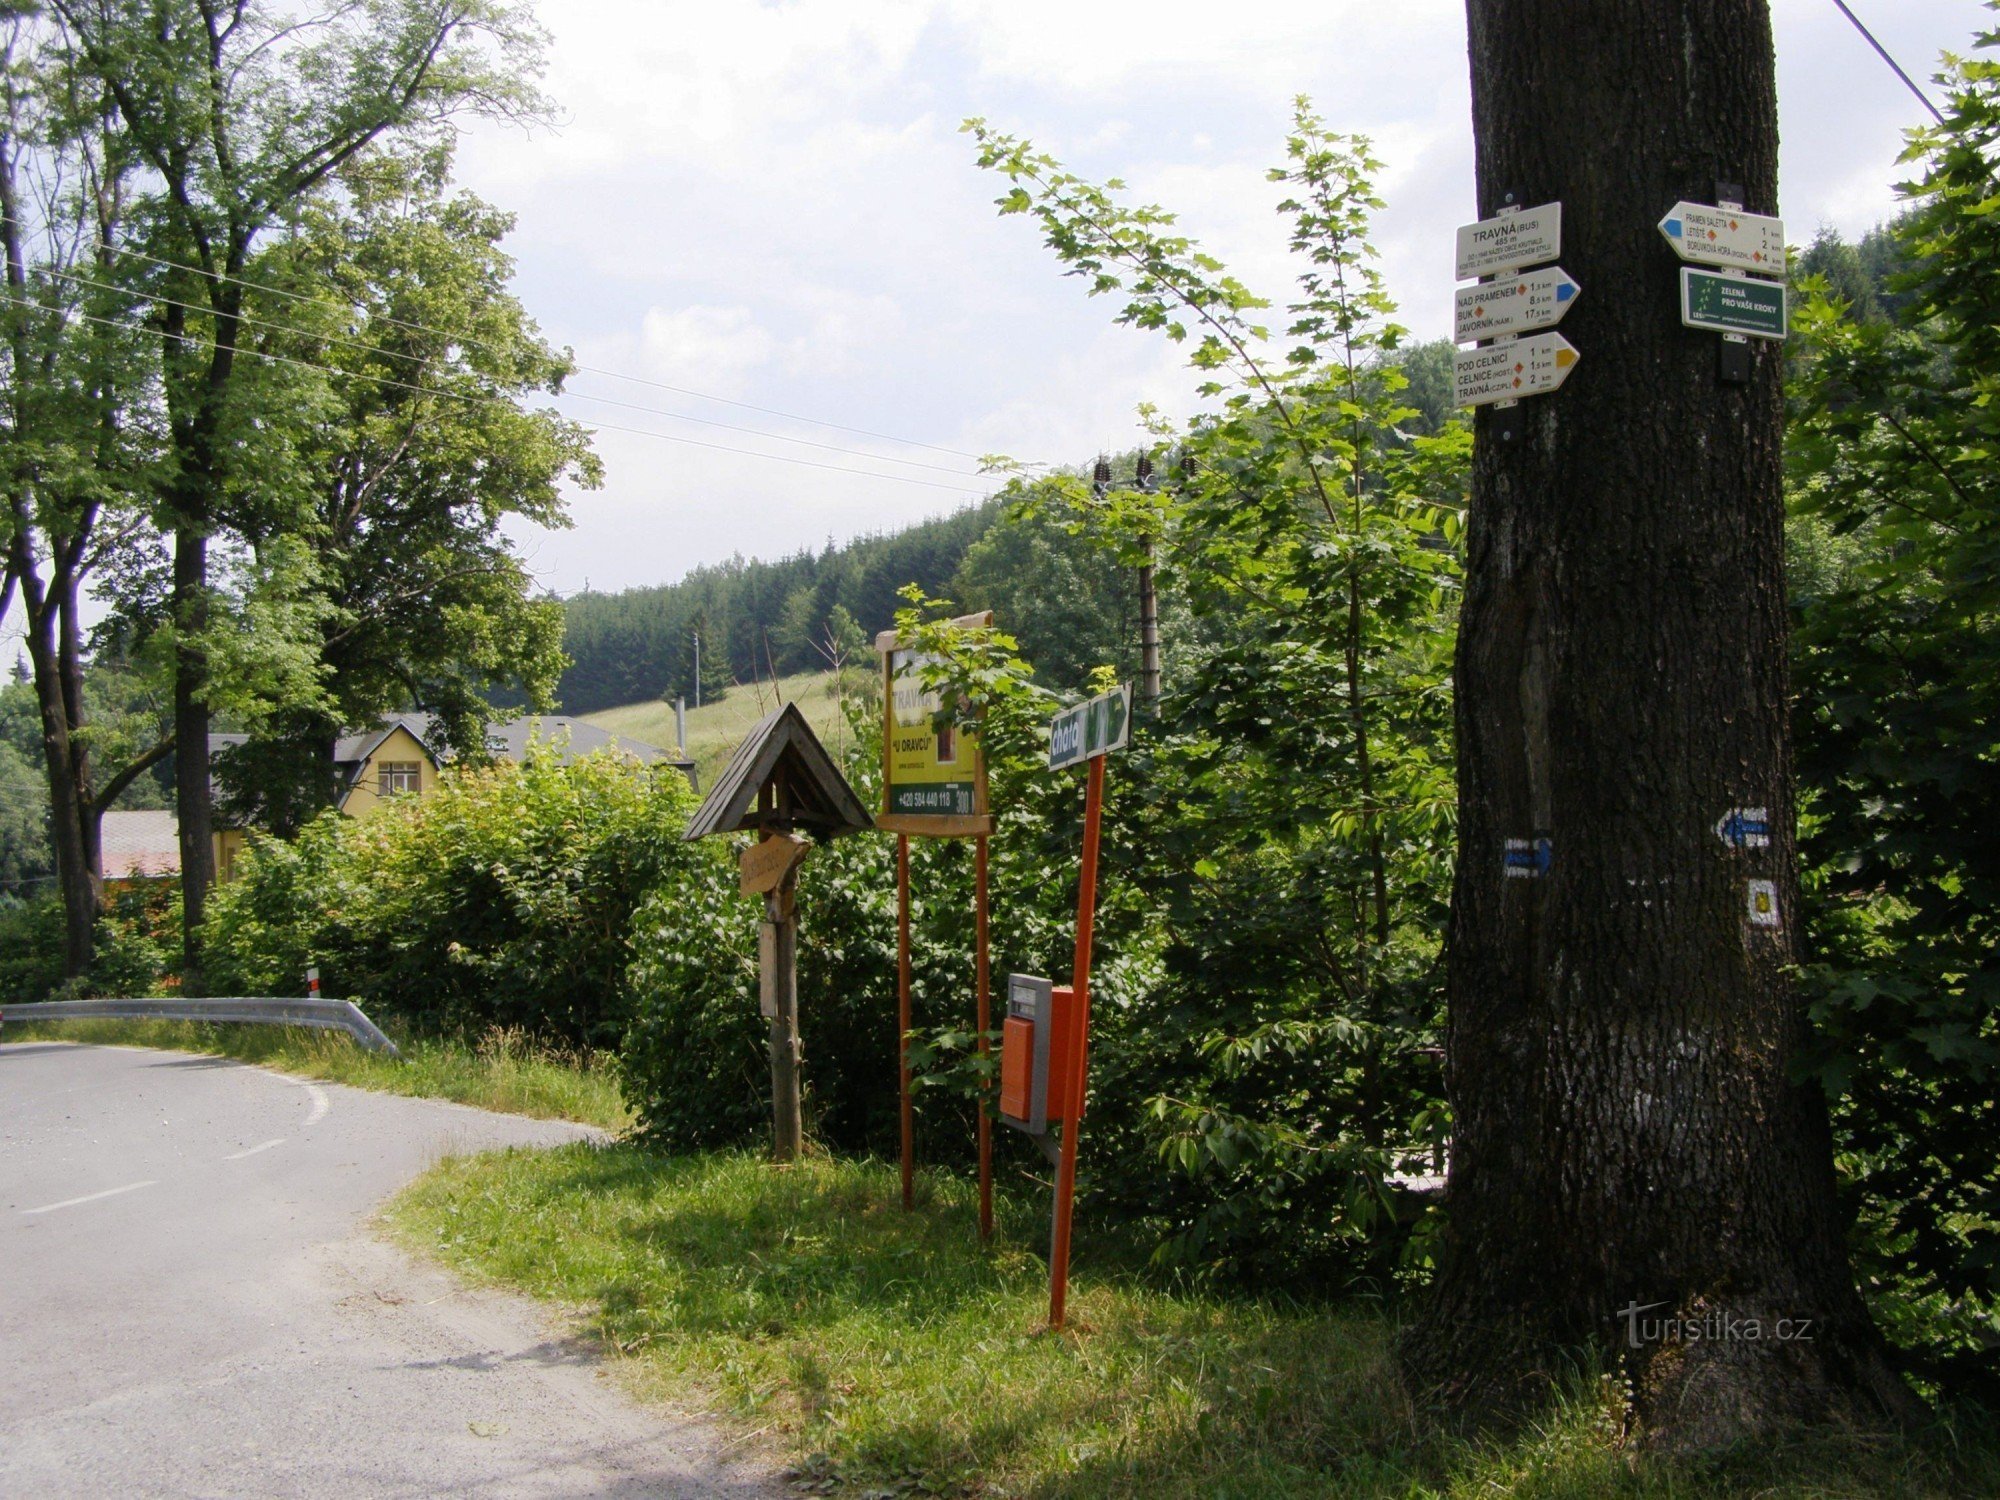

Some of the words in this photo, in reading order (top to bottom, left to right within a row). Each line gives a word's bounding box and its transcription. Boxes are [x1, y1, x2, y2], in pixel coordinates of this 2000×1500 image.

[1473, 223, 1517, 243] TRAVNÁ
[1517, 220, 1538, 233] (BUS)
[1762, 227, 1766, 236] 1
[1494, 237, 1507, 246] 485
[1762, 241, 1767, 249] 2
[1762, 254, 1767, 262] 4
[1458, 296, 1473, 307] NAD
[1475, 287, 1517, 303] PRAMENEM
[1721, 287, 1746, 297] ZELENÁ
[1722, 298, 1735, 307] PRO
[1736, 301, 1752, 310] VAŠE
[1754, 304, 1777, 314] KROKY
[1458, 310, 1473, 320] BUK
[1458, 317, 1493, 333] JAVORNÍK
[1530, 347, 1535, 356] 1
[1458, 361, 1474, 372] POD
[1476, 352, 1508, 365] CELNICÍ
[1458, 370, 1492, 385] CELNICE
[1530, 375, 1535, 384] 2
[1459, 384, 1489, 398] TRAVNÁ
[1053, 720, 1079, 756] chata
[899, 792, 913, 807] +420
[926, 792, 938, 807] 440
[939, 792, 951, 807] 118
[956, 790, 969, 813] 300
